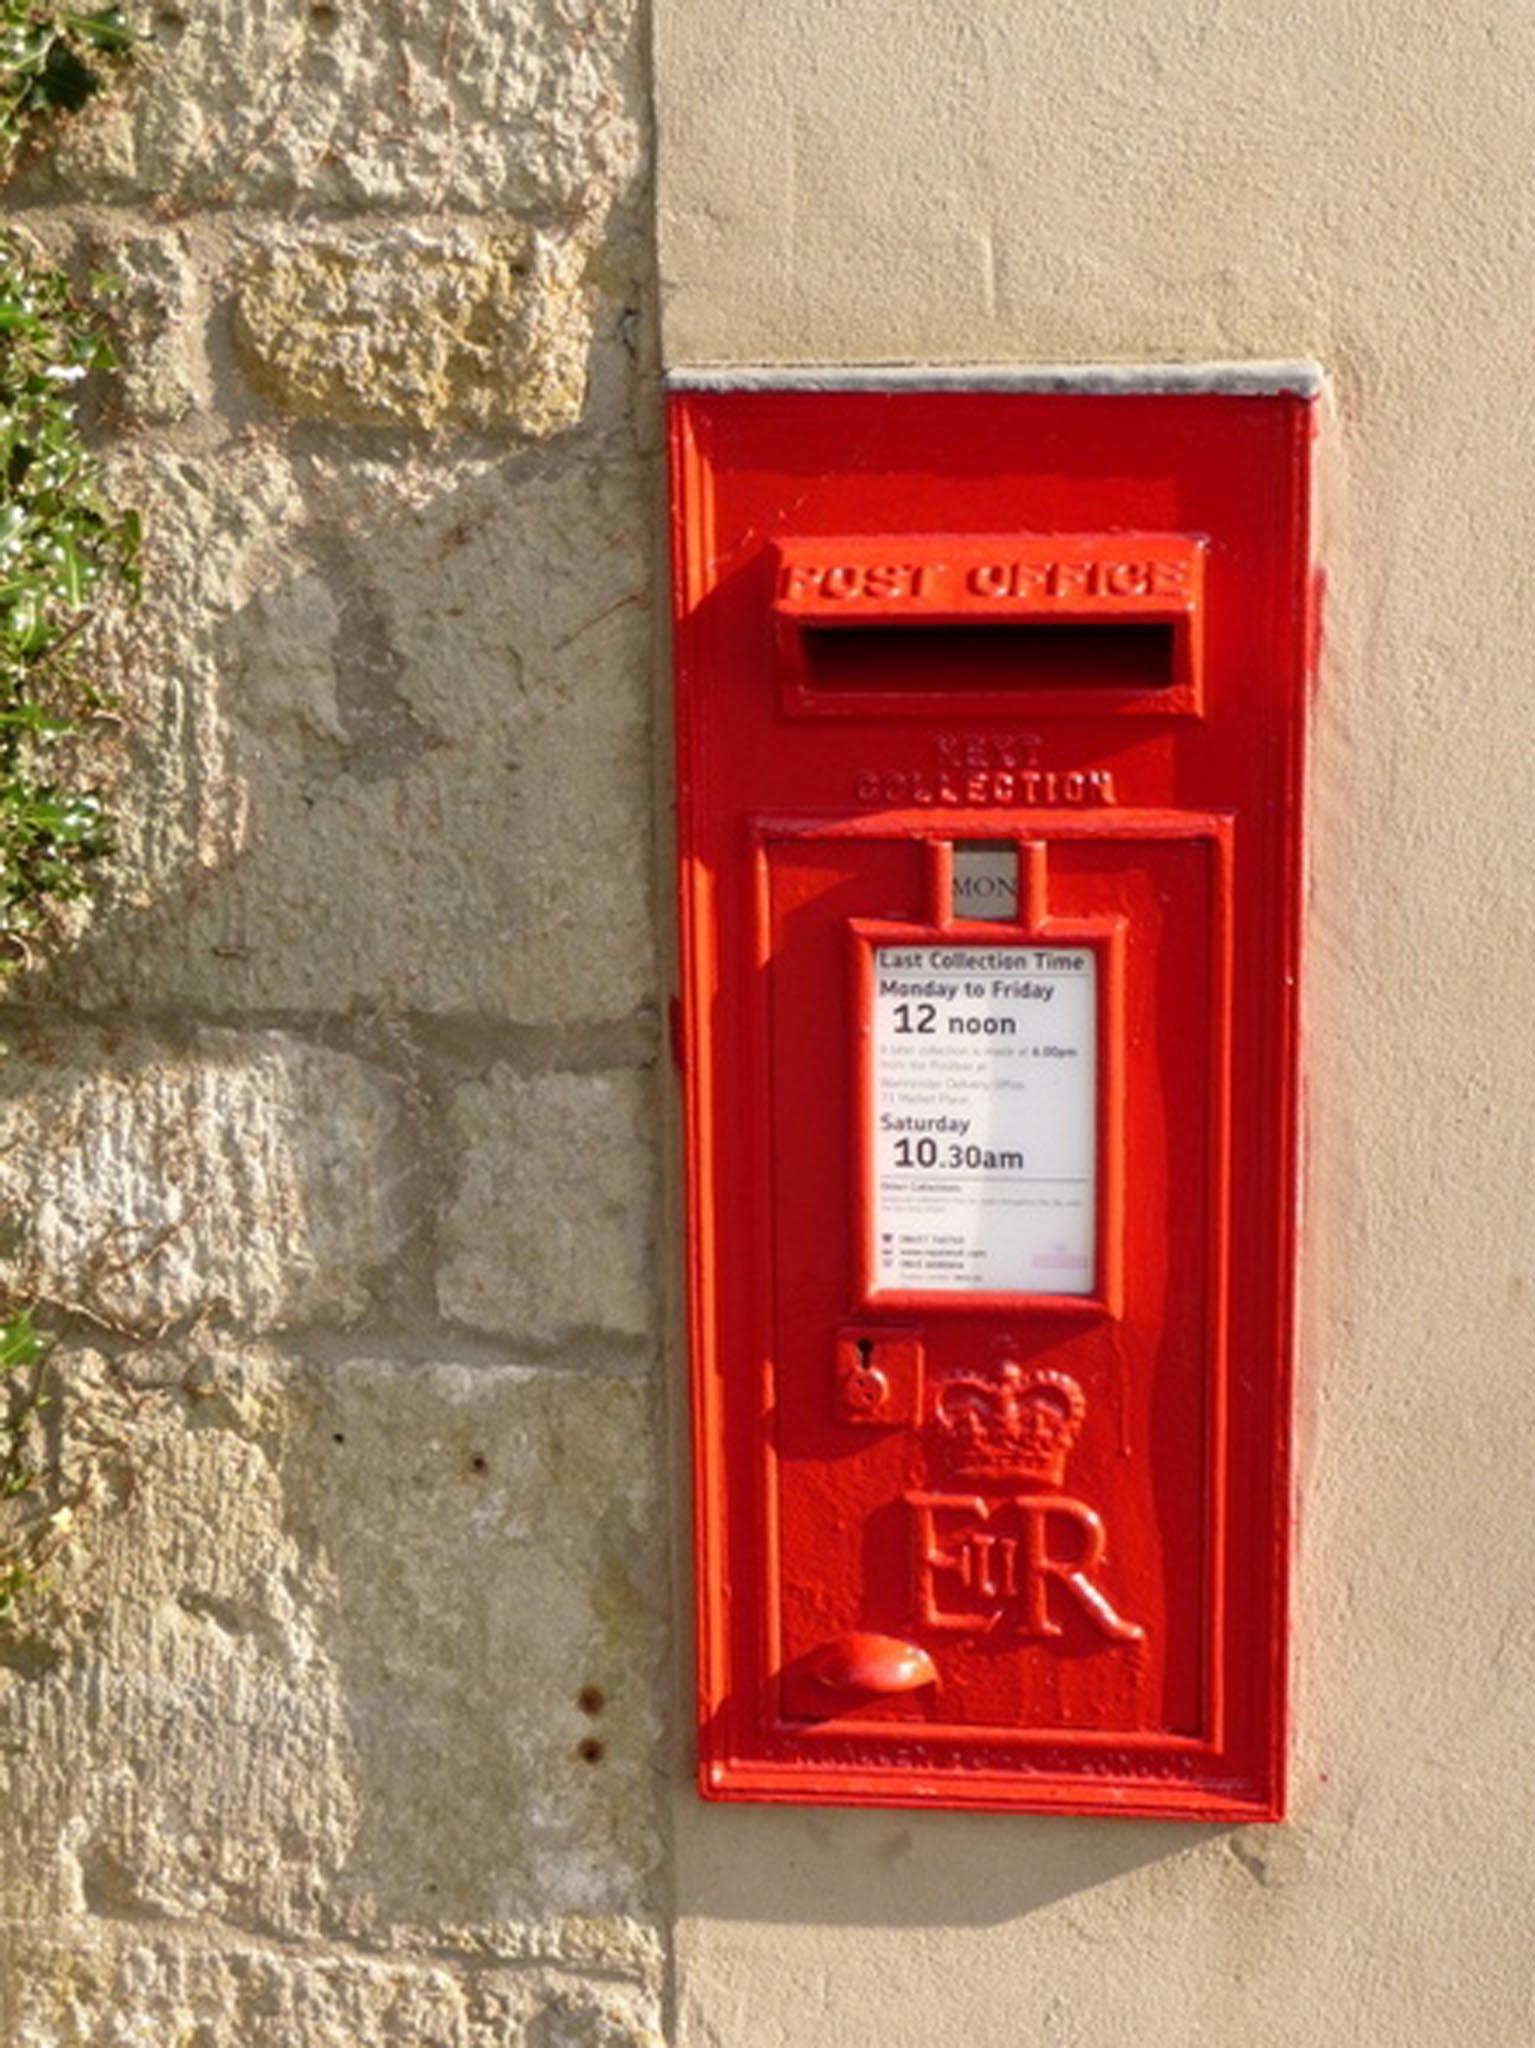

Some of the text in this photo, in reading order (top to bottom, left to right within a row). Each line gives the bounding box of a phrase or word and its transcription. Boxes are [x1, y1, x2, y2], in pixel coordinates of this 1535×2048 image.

[778, 560, 1190, 601] POST OFFICE
[855, 769, 1116, 806] COLLECTION
[952, 875, 1016, 899] MON
[879, 951, 1085, 971] Last Collection Time
[880, 979, 1055, 1002] Monday to Friday
[893, 1003, 1017, 1035] 12 noon
[880, 1113, 972, 1136] Saturday
[893, 1136, 1025, 1170] 10.30am
